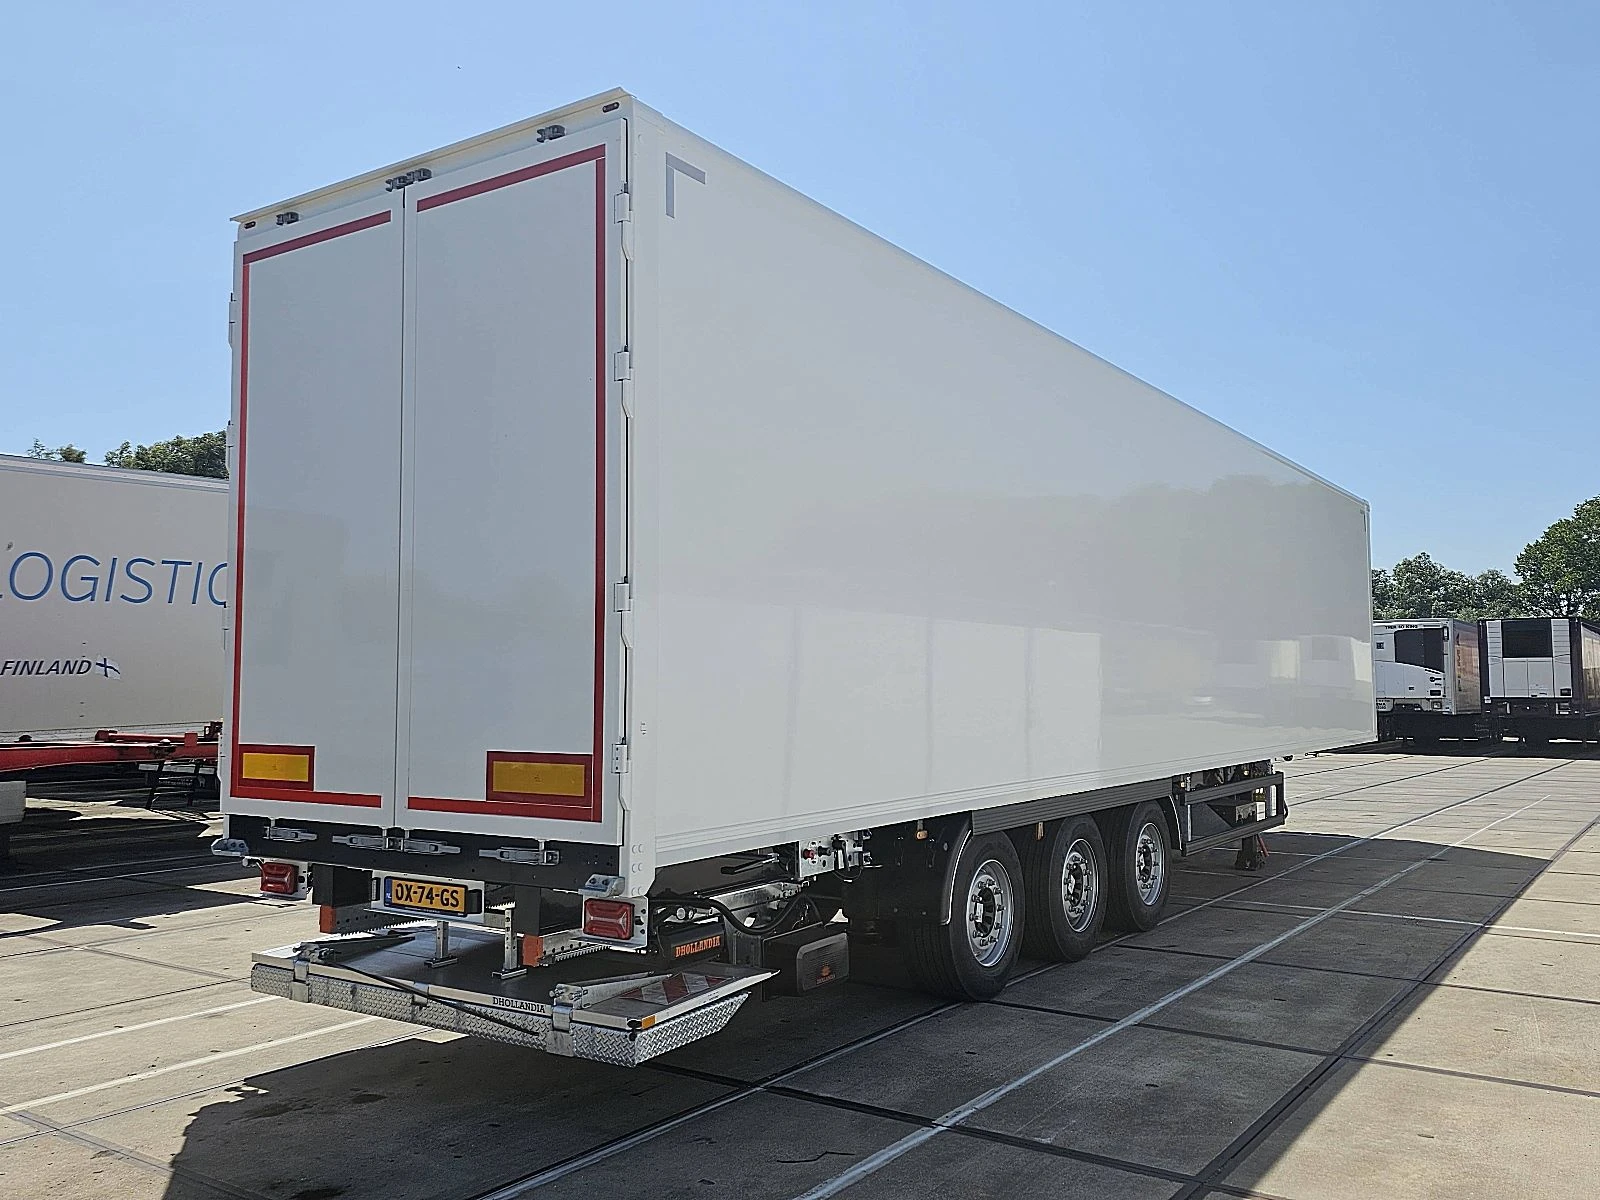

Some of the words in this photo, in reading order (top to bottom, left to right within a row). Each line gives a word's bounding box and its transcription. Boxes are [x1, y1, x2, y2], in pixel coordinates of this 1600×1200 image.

[0, 552, 228, 606] OGISTIC
[0, 660, 92, 676] FINLAND
[395, 883, 460, 908] OX-74-GS
[675, 935, 721, 958] DHOLLANDIA
[492, 996, 546, 1013] DHOLLANDIA
